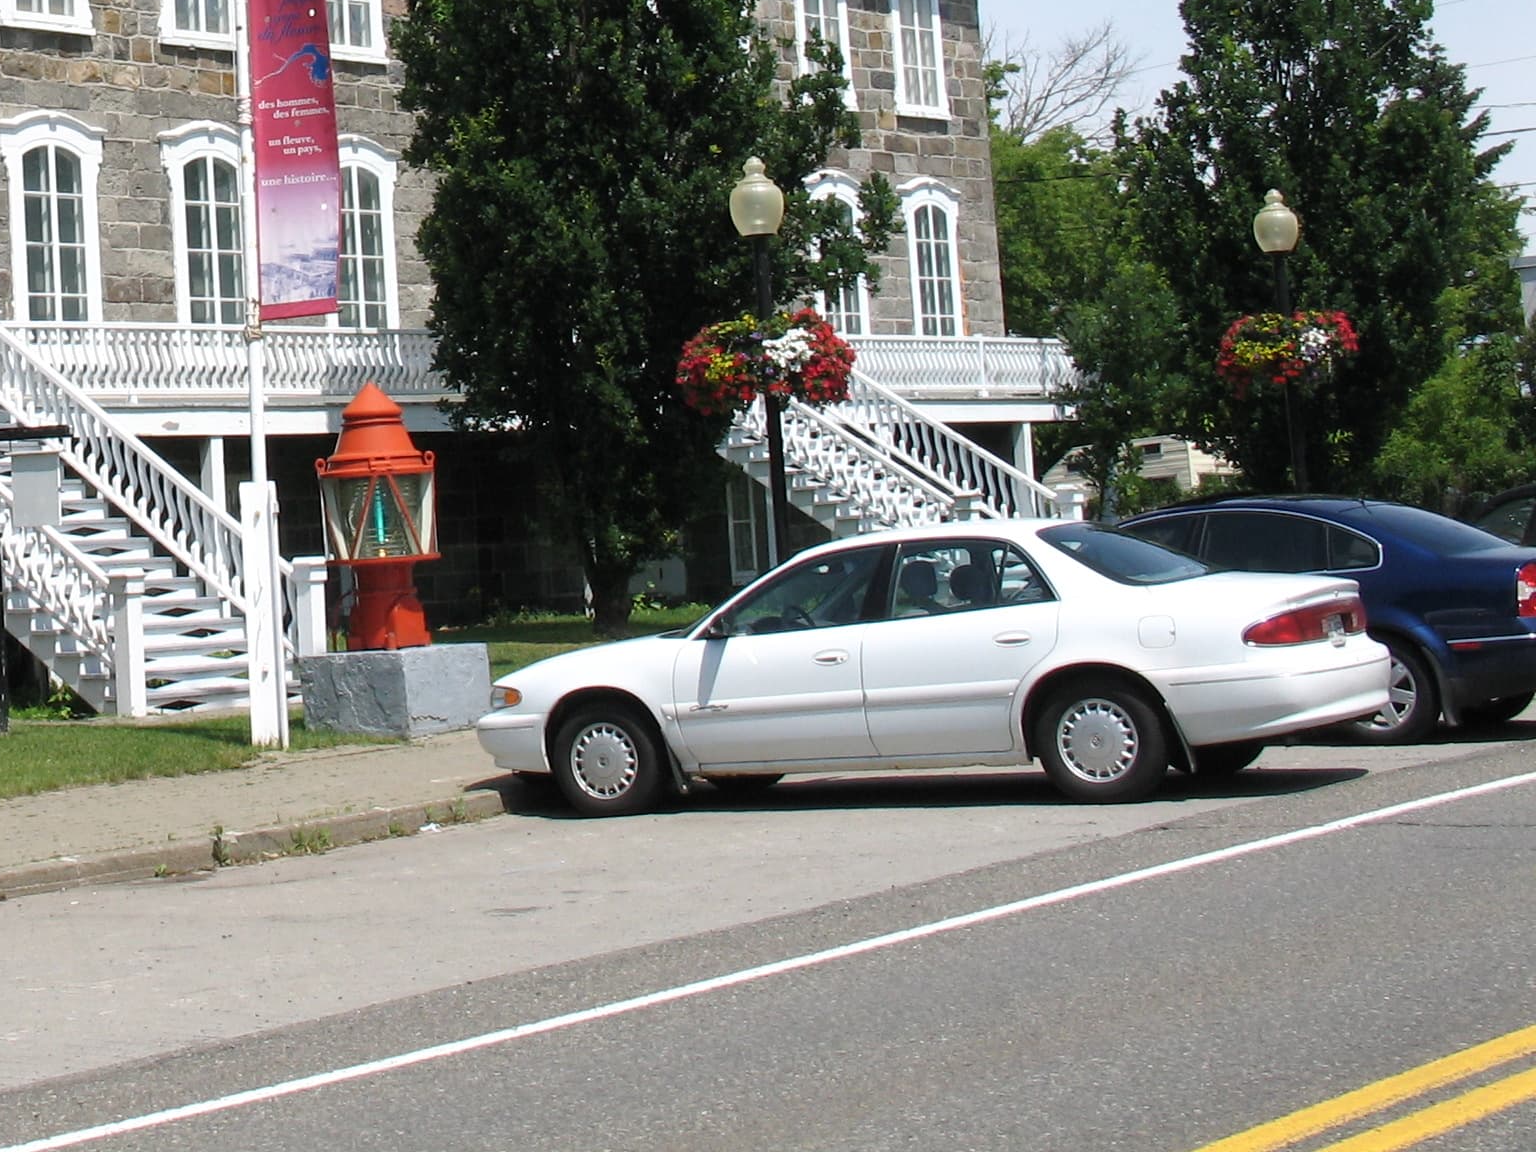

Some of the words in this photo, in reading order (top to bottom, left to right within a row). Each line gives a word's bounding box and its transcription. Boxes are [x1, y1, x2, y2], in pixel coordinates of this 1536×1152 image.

[258, 100, 275, 110] des
[273, 109, 289, 119] des
[268, 138, 281, 147] un
[260, 178, 282, 187] une
